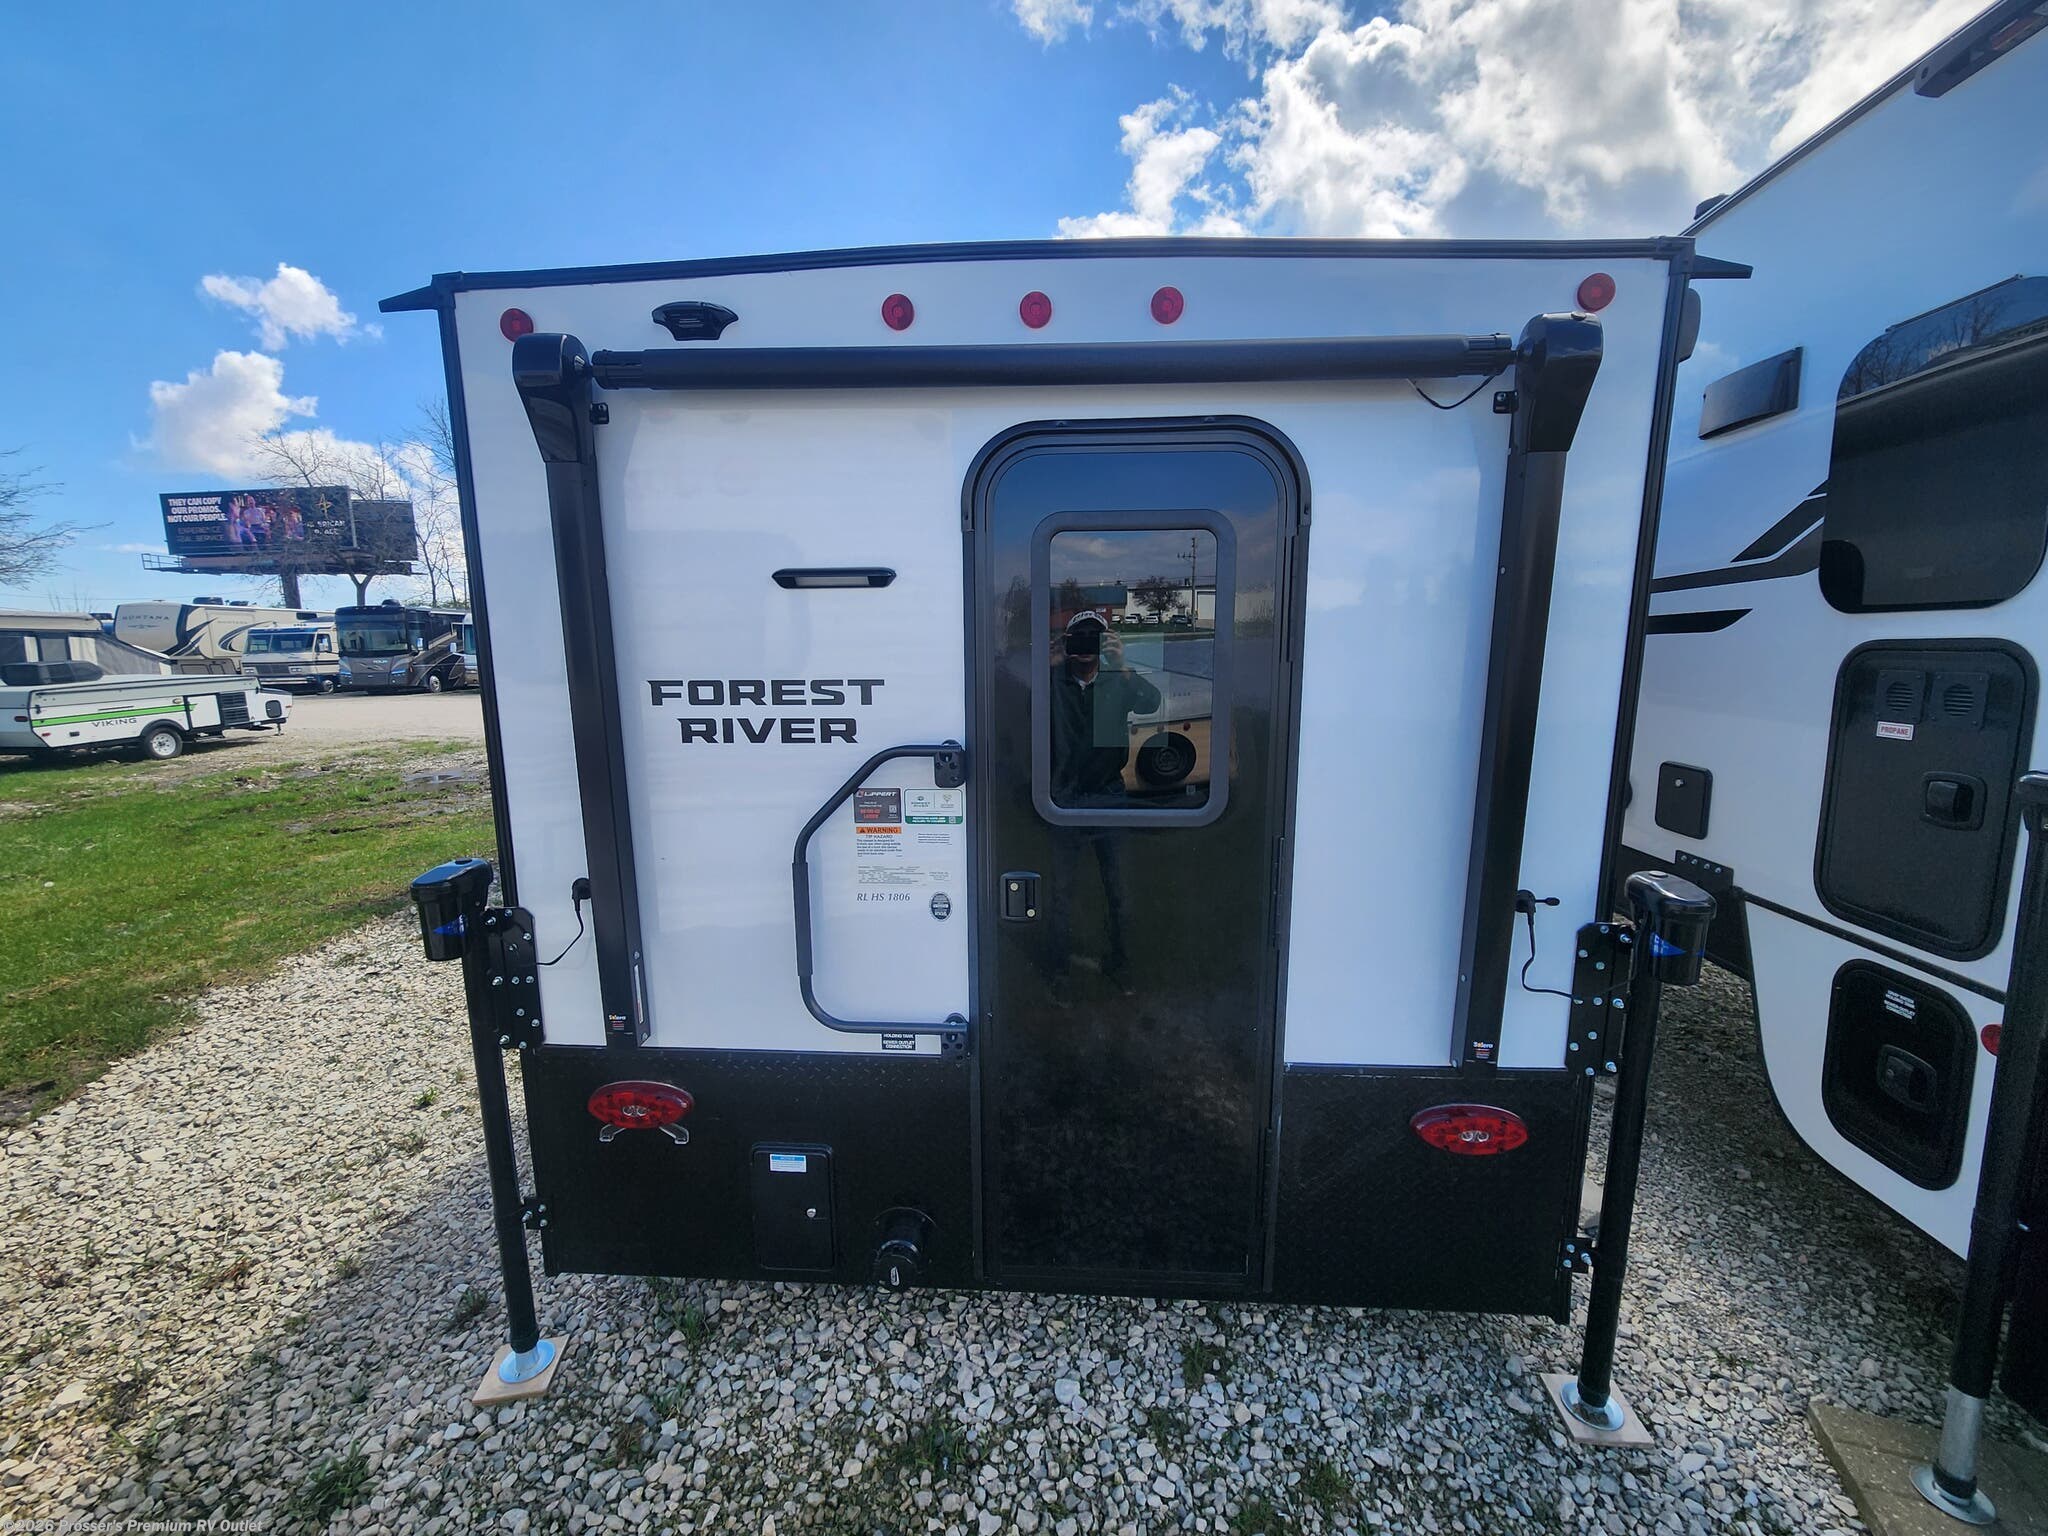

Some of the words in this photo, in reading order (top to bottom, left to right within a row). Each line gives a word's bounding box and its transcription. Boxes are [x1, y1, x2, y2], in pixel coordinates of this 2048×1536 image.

[168, 498, 186, 507] THEY
[187, 497, 202, 506] CAN
[203, 496, 222, 505] COPY
[171, 506, 188, 514] OUR
[168, 514, 183, 523] NOT
[183, 514, 199, 522] OUR
[646, 679, 885, 706] FOREST
[92, 717, 138, 728] VIKING
[677, 718, 859, 744] RIVER
[1880, 725, 1909, 736] PROPANE
[857, 893, 868, 901] RL
[871, 893, 885, 901] HS
[888, 892, 911, 901] 1806
